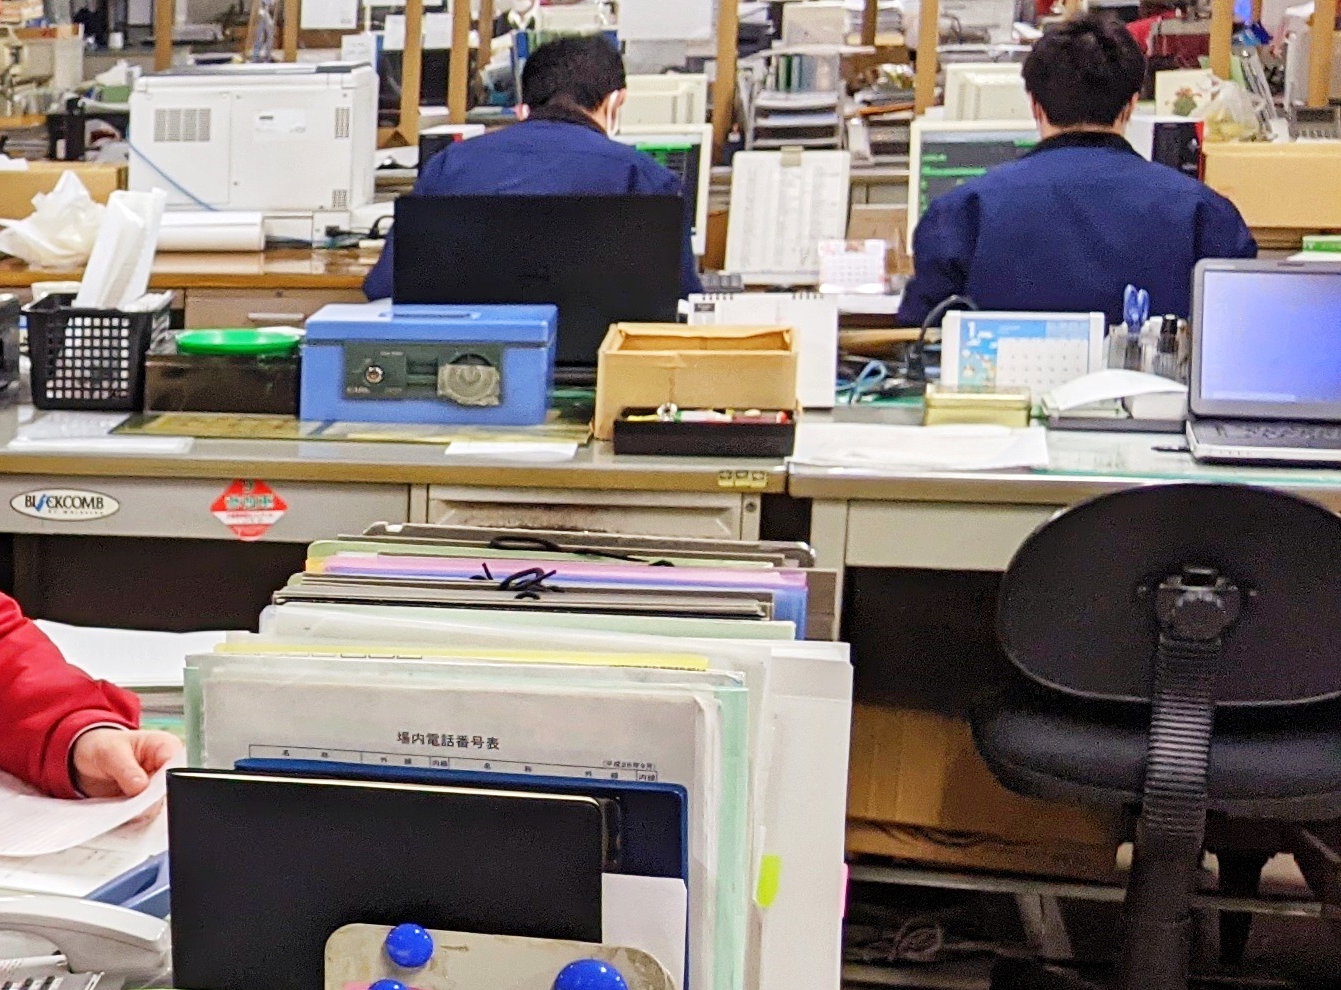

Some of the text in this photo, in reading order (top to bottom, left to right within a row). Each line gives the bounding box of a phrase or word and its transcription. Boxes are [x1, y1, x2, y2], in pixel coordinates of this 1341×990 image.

[397, 731, 501, 751] 場内電話番号表
